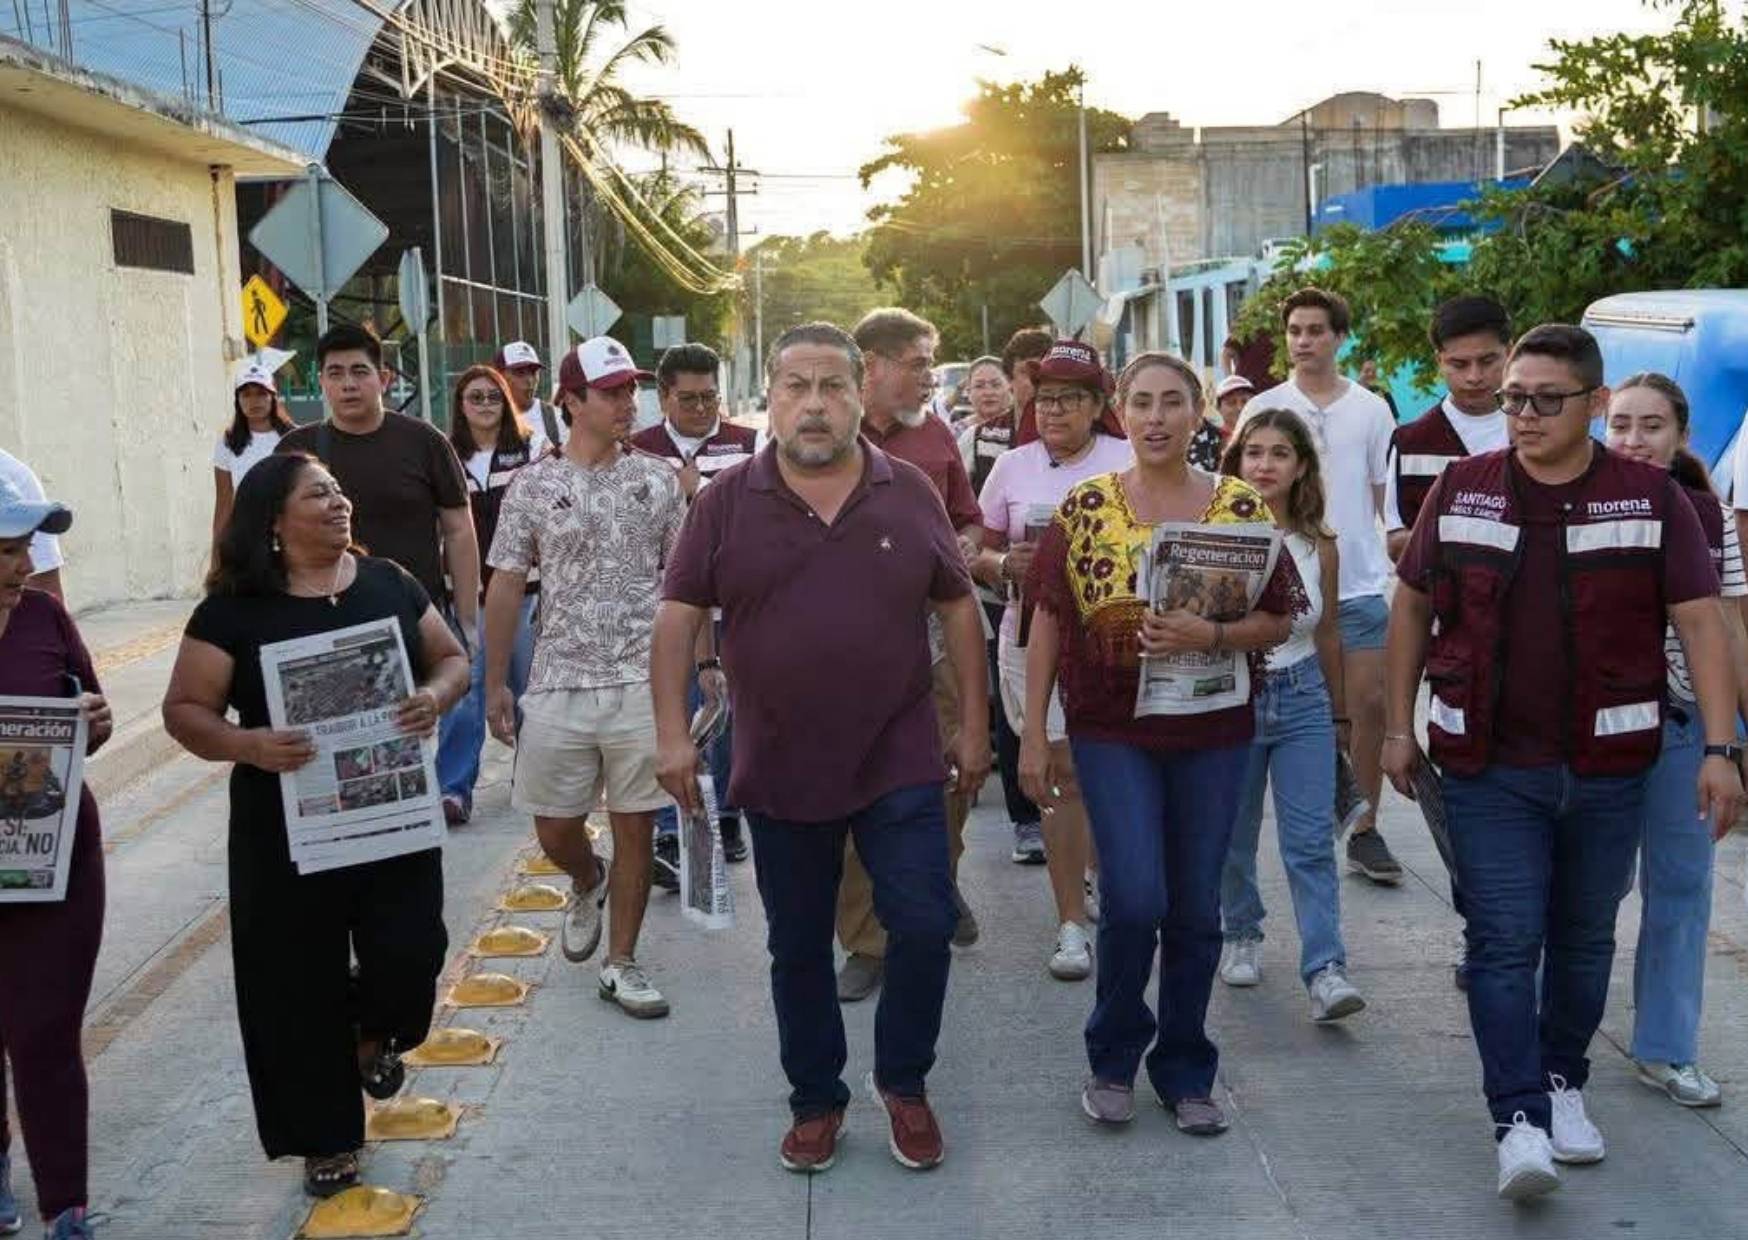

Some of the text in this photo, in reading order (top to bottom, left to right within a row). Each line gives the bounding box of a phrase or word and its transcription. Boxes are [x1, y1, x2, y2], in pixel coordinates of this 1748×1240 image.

[1456, 491, 1506, 509] SANTIAGO
[1587, 498, 1652, 514] morena
[26, 832, 54, 855] NO
